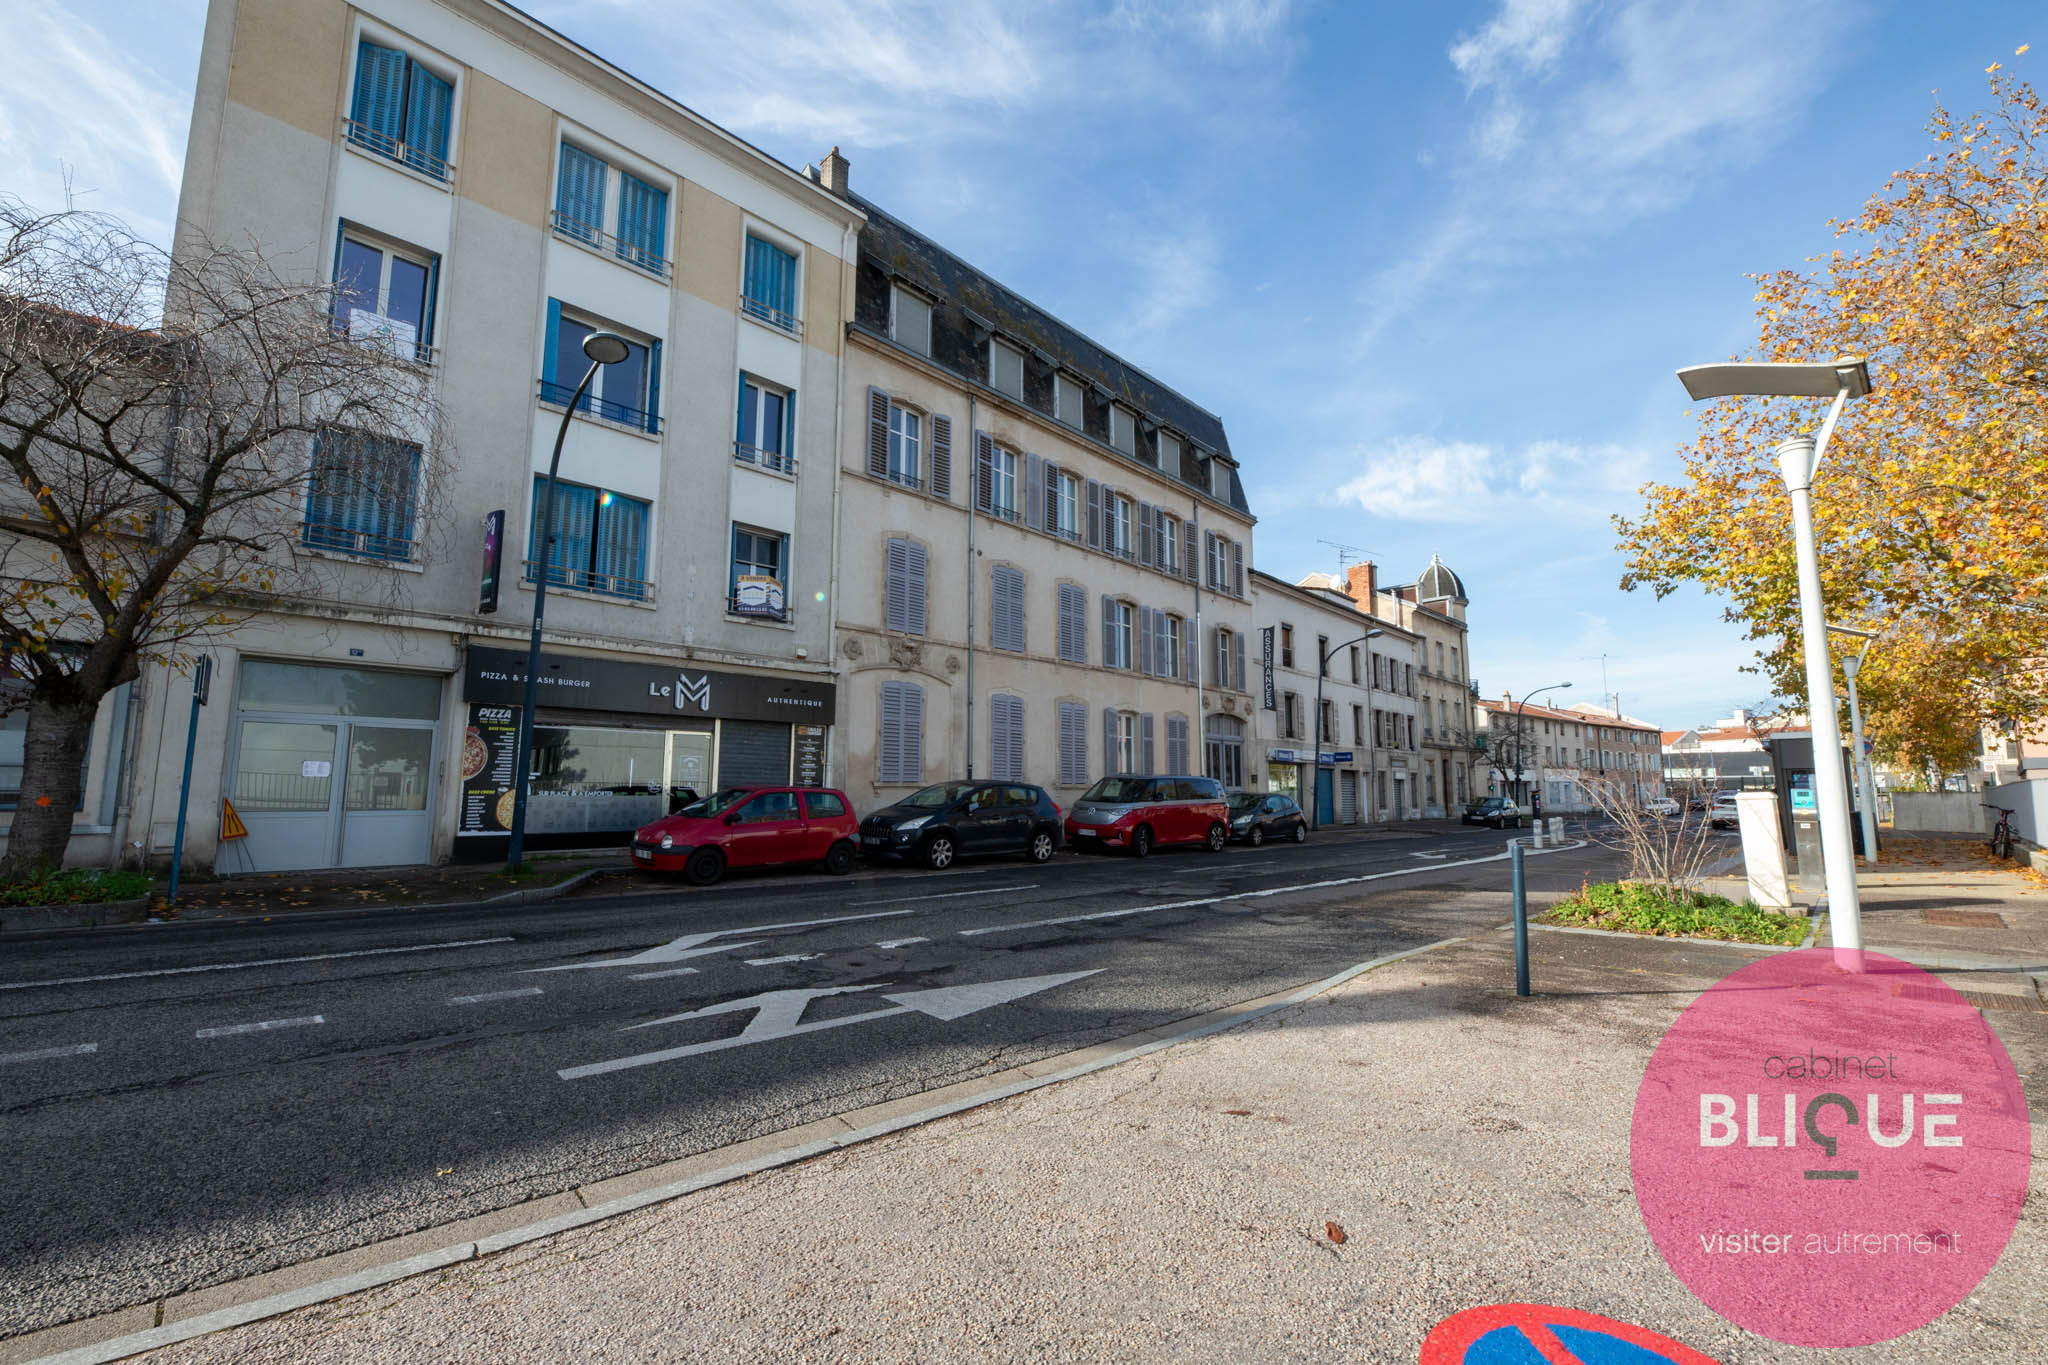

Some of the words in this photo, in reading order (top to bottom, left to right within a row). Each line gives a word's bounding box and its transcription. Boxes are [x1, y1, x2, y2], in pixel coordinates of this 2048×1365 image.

[1265, 630, 1273, 707] ASSURANCES
[480, 671, 507, 680] PIZZA
[512, 674, 519, 682] &
[523, 675, 554, 684] SASH
[558, 678, 591, 688] BURGER
[650, 682, 671, 696] Le
[676, 673, 710, 711] M
[768, 697, 822, 707] AUTHENTIQUE
[479, 708, 511, 718] PIZZA
[550, 790, 569, 798] PLACE
[584, 790, 613, 798] EMPORTER
